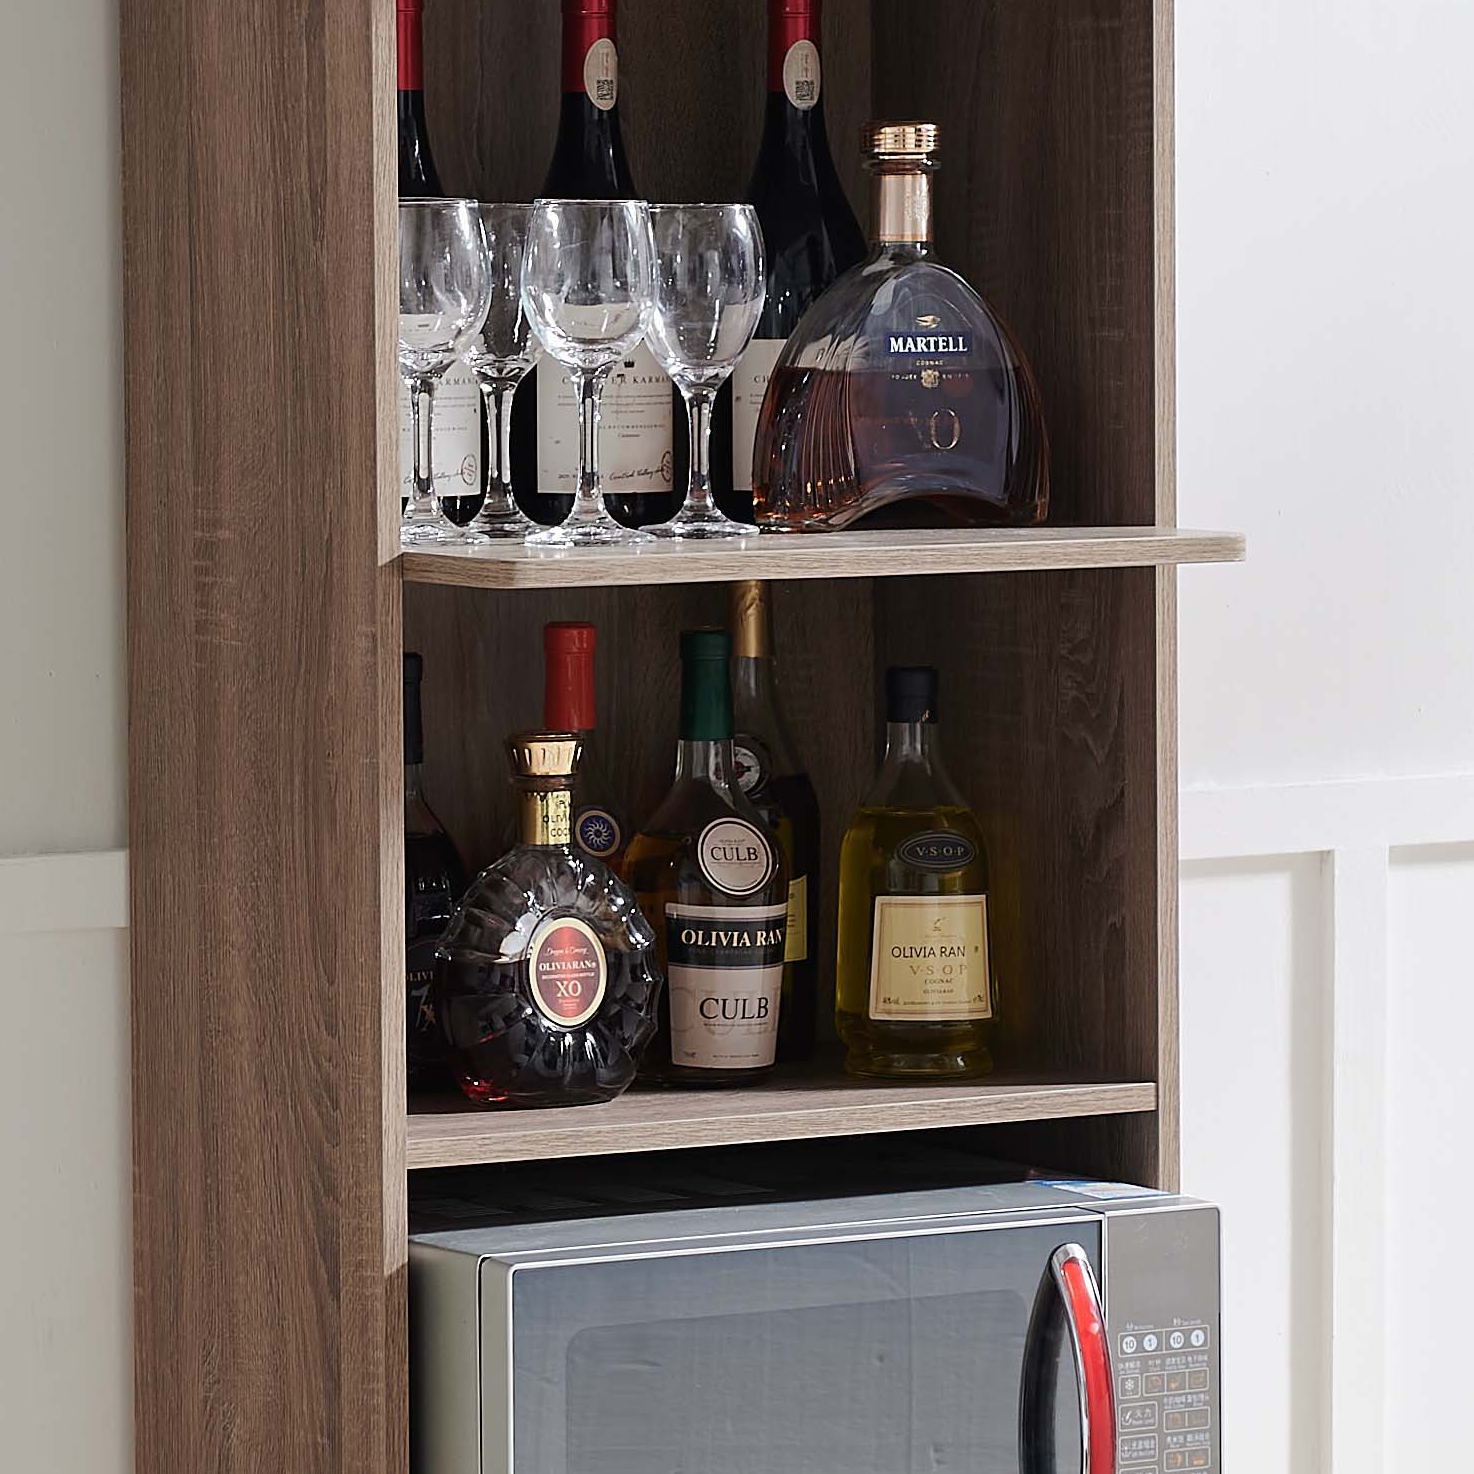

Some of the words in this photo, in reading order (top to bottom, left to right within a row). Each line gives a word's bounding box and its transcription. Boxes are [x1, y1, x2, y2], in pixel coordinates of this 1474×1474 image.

[890, 336, 967, 353] MARTELL
[710, 846, 759, 862] CULB
[681, 929, 751, 947] OLIVIA
[756, 929, 782, 946] RAN
[891, 945, 937, 958] OLIVIA
[940, 945, 966, 958] RAN
[556, 980, 582, 998] XO
[924, 977, 954, 985] COGNAC
[699, 997, 770, 1020] CULB
